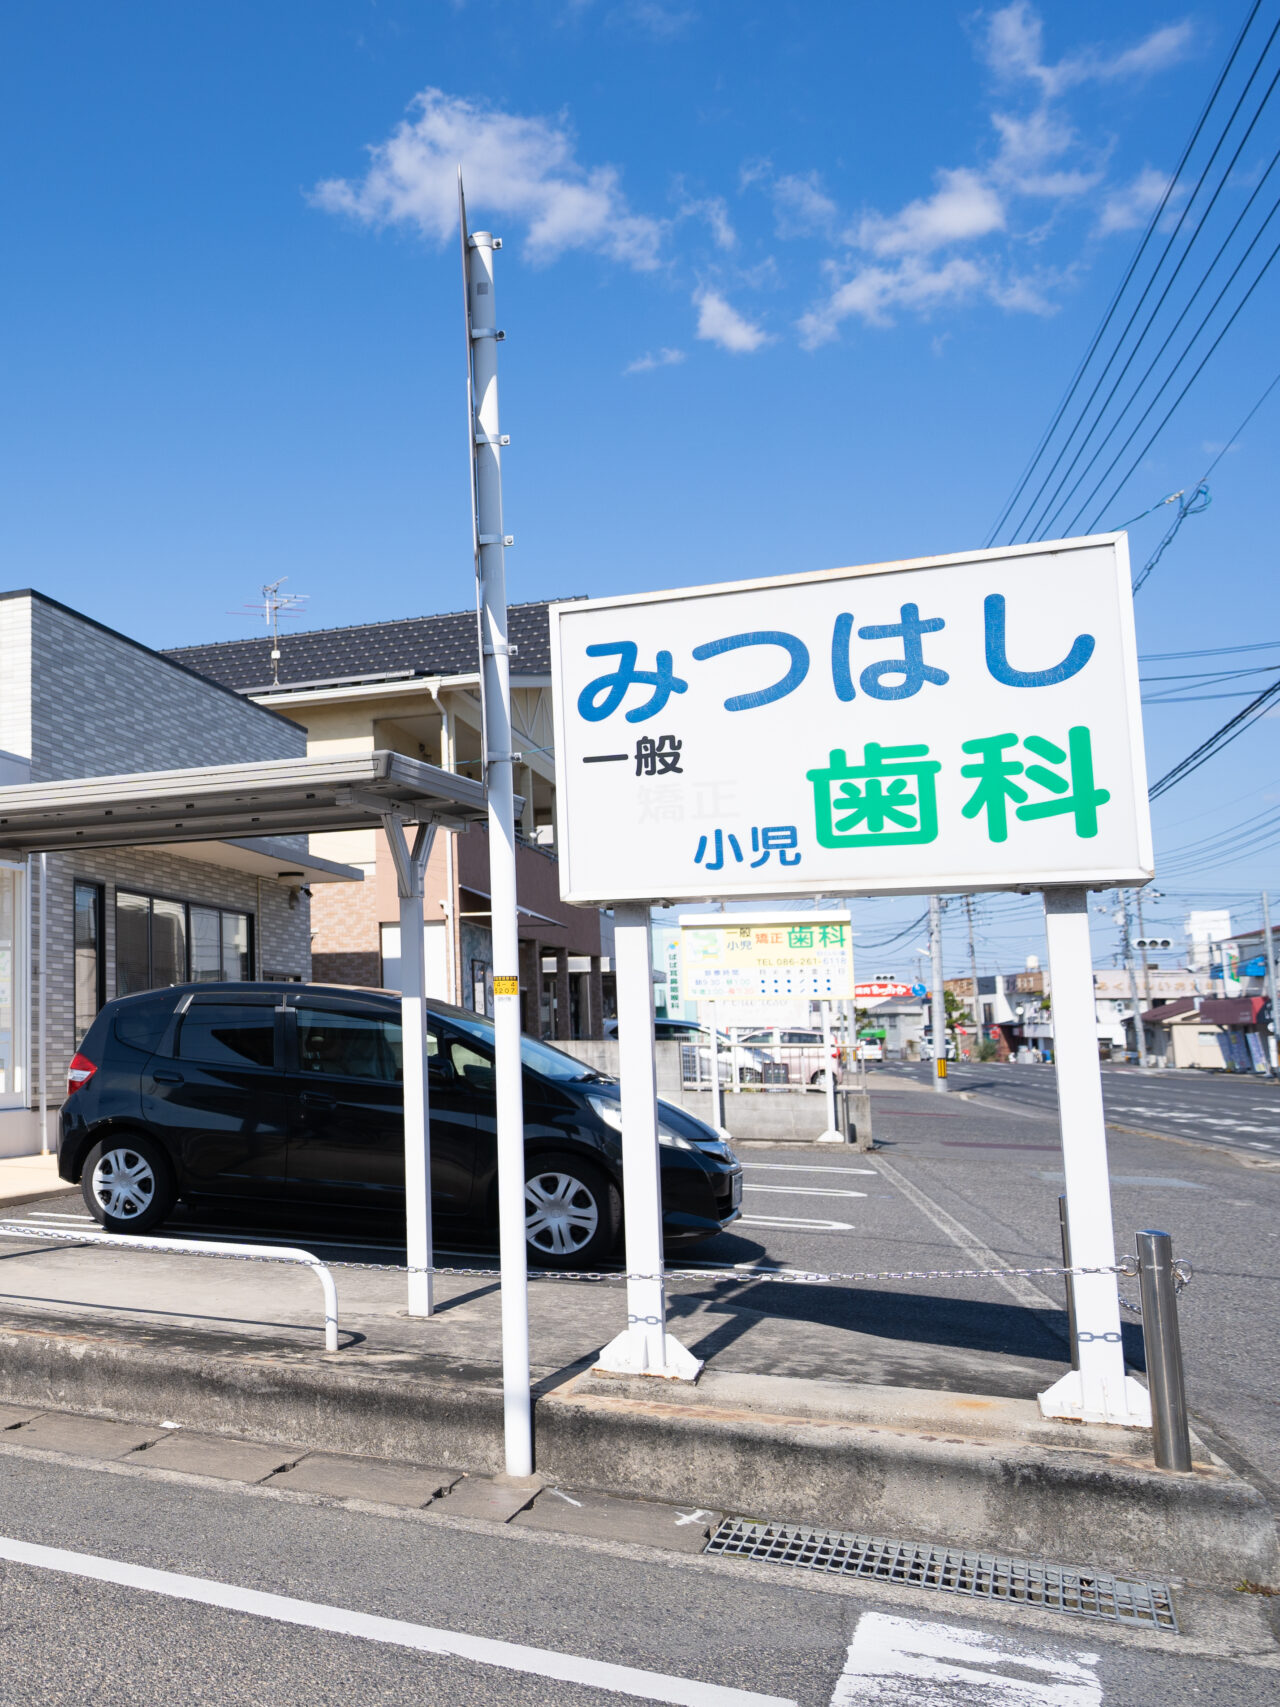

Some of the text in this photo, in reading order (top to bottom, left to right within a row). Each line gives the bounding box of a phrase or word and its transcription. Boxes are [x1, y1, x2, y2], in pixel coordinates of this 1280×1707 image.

[577, 593, 1096, 723] みつはし
[582, 735, 684, 777] 一般
[636, 779, 740, 824] 矯正
[806, 726, 1111, 849] 歯科
[693, 825, 802, 871] 小児
[726, 940, 752, 951] 小児
[755, 932, 783, 944] 矯正
[787, 924, 846, 949] 歯科
[757, 958, 773, 967] TEL
